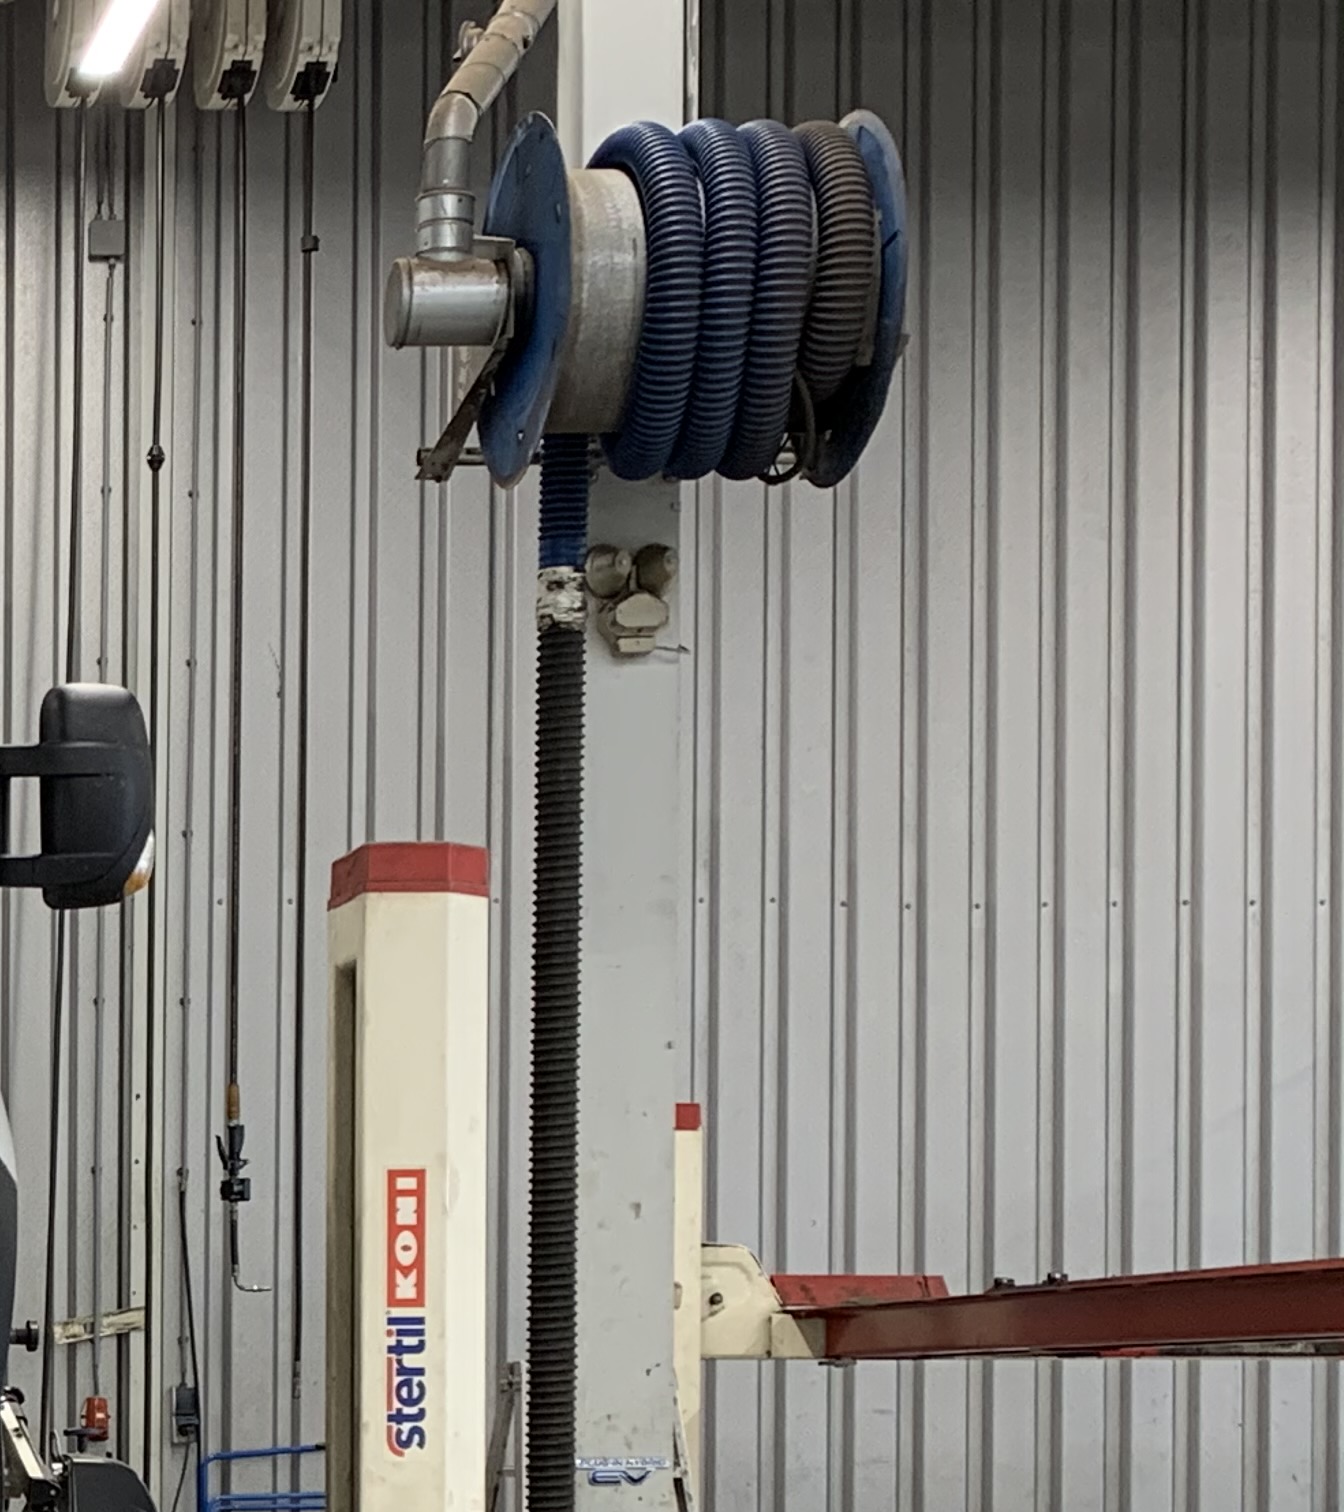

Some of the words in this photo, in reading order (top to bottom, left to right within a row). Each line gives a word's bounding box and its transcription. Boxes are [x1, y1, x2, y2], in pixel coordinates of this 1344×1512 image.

[393, 1174, 420, 1301] KONI
[386, 1315, 426, 1453] stertil
[588, 1469, 653, 1486] EV
